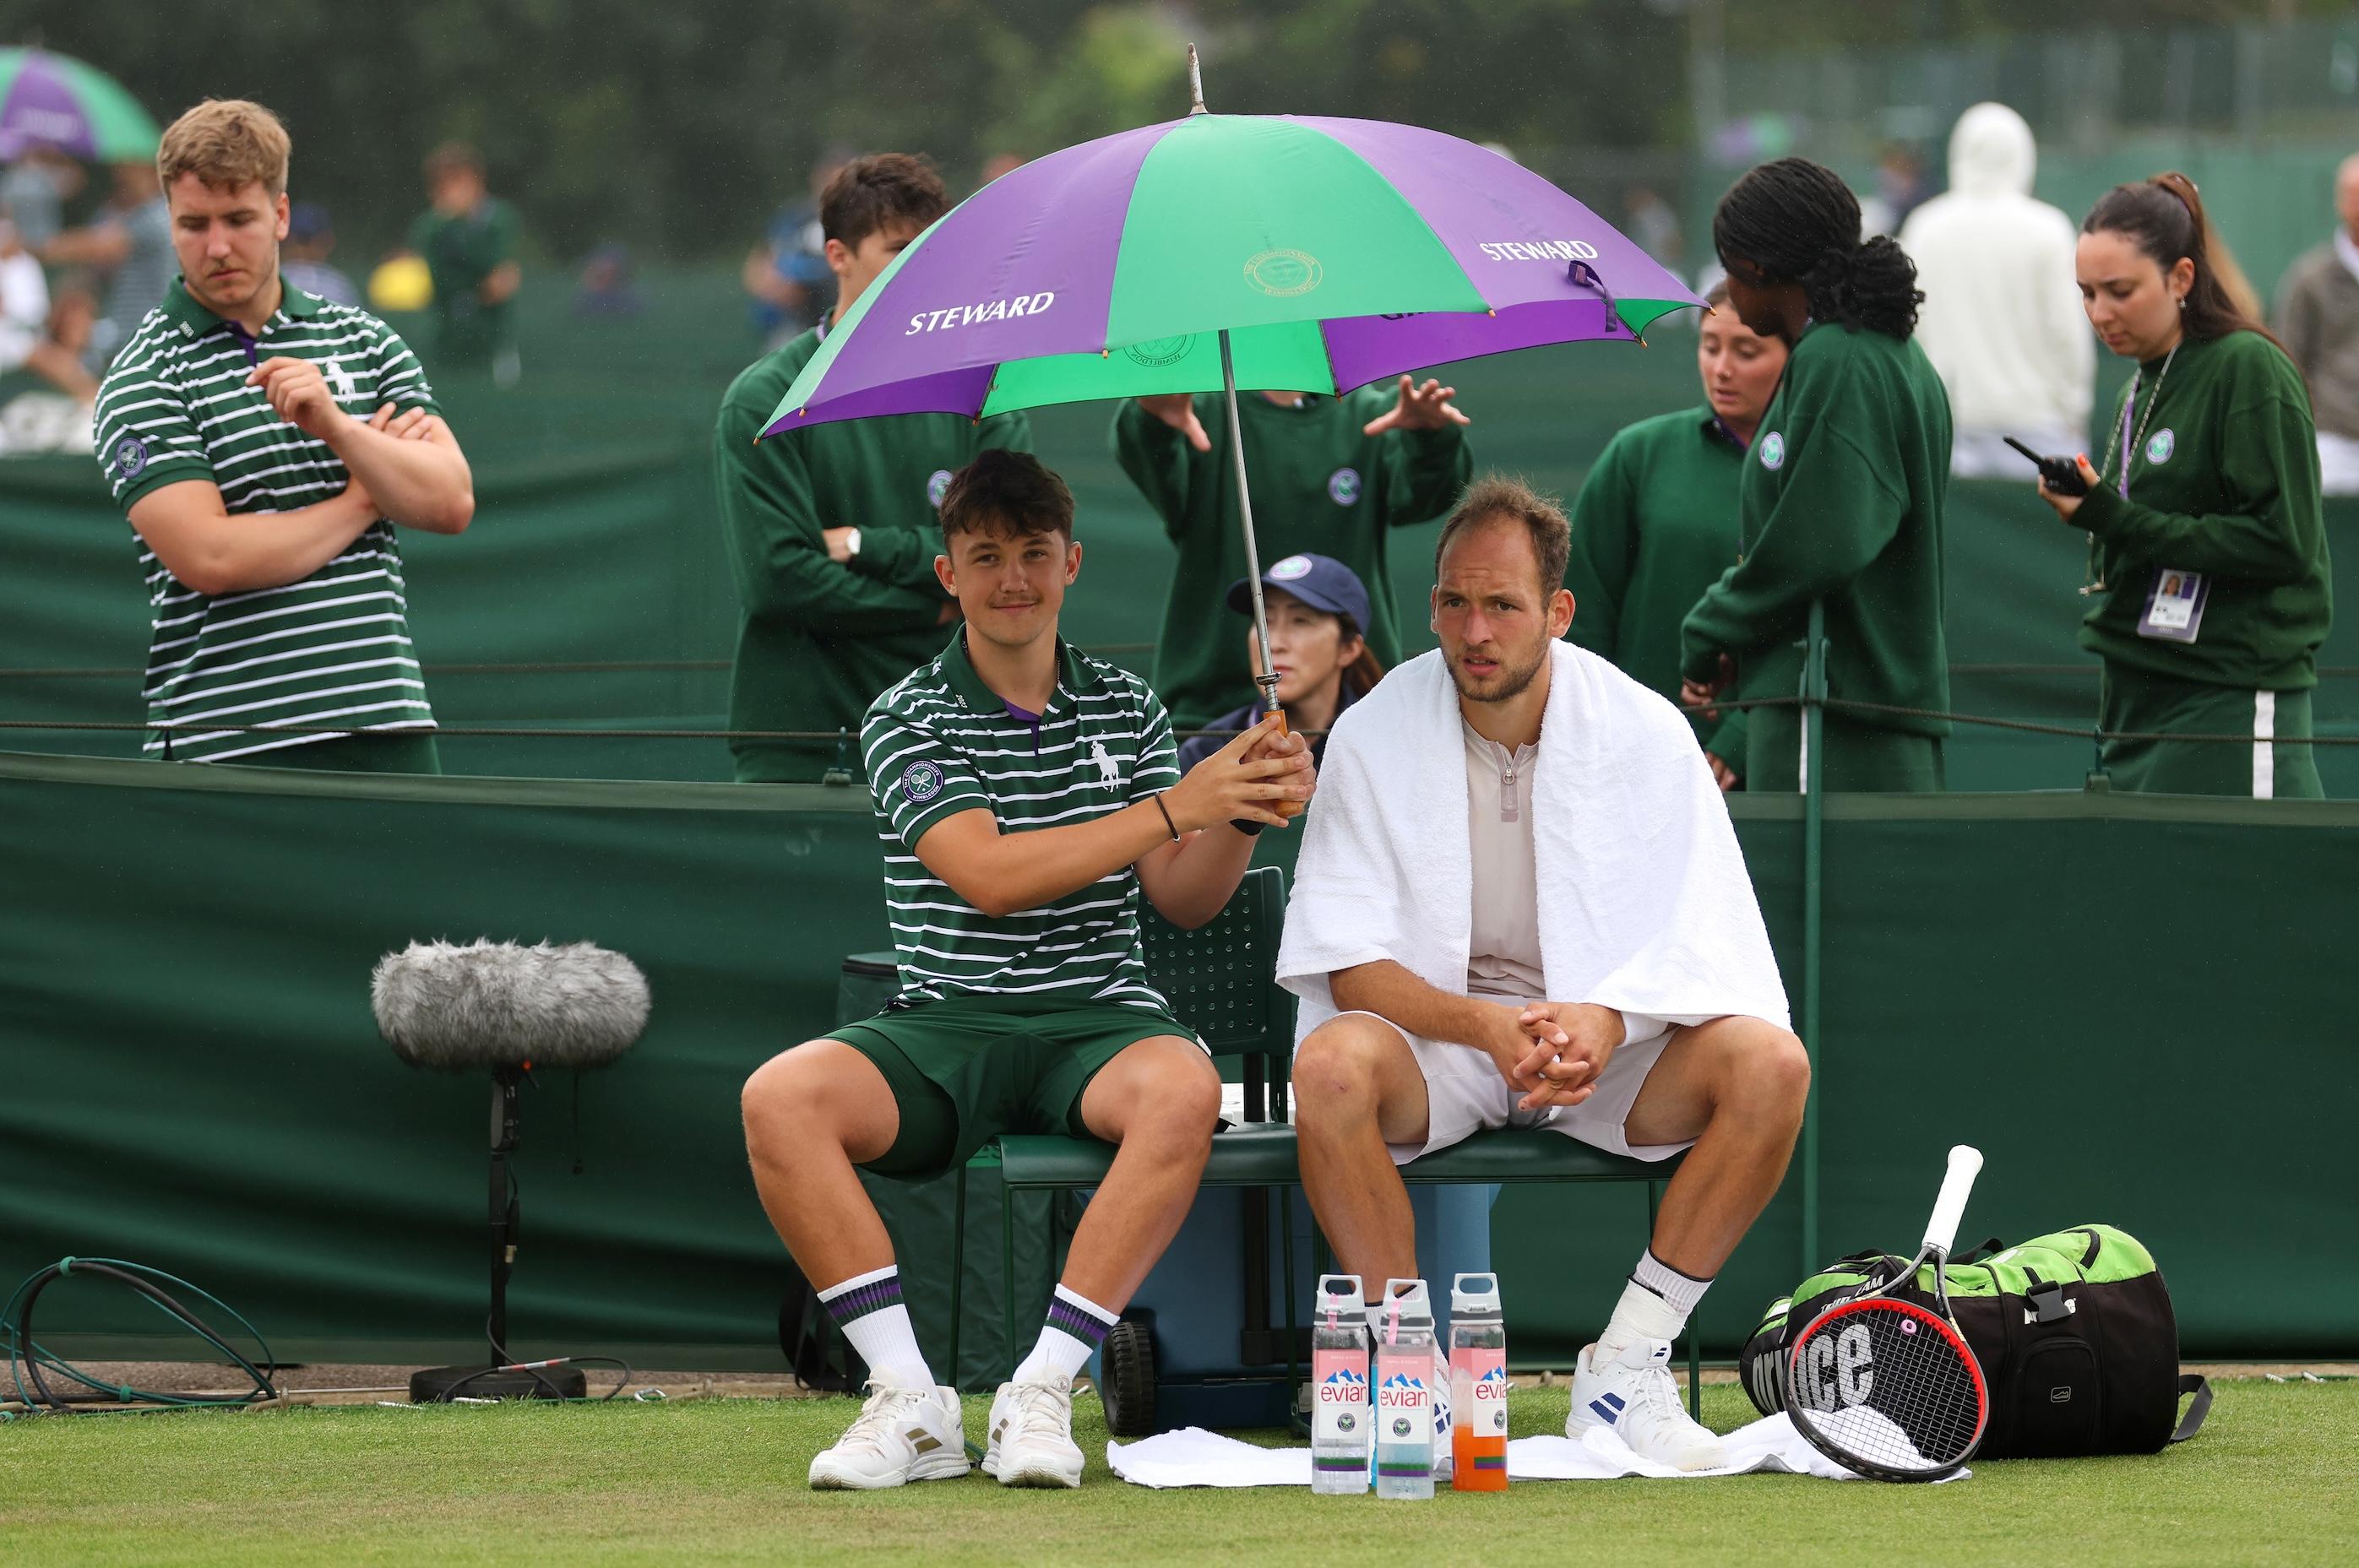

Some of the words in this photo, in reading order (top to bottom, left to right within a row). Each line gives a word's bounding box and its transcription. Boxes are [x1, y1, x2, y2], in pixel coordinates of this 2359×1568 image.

[1479, 240, 1598, 261] STEWARD
[905, 291, 1055, 335] STEWARD
[905, 762, 940, 777] CHAMPIONSHIPS
[912, 784, 940, 800] WIMBLEDON
[1380, 1387, 1428, 1407] evian
